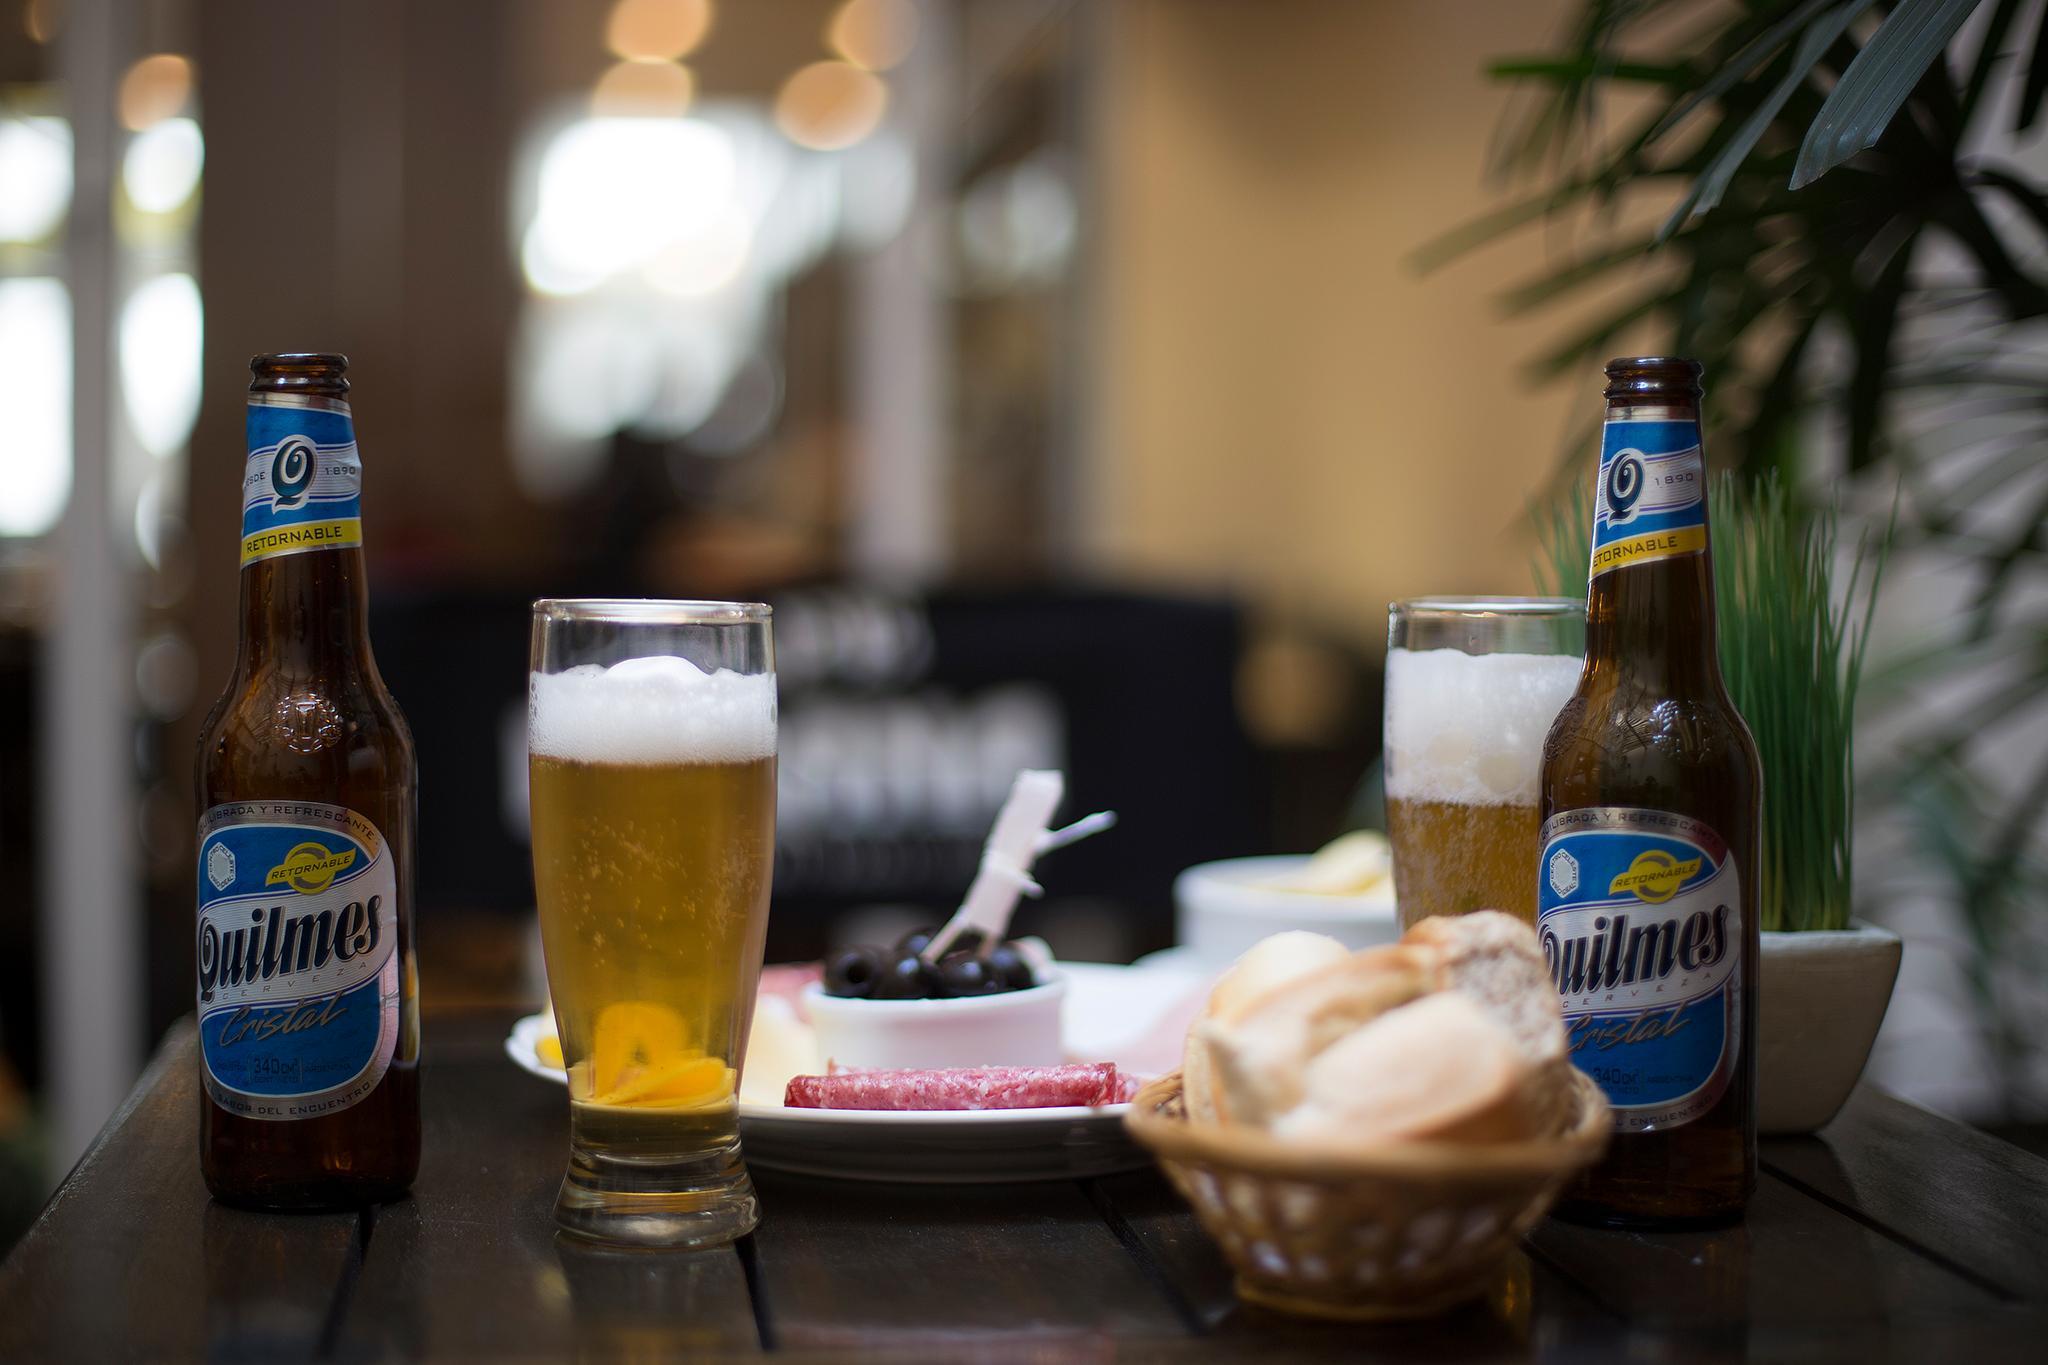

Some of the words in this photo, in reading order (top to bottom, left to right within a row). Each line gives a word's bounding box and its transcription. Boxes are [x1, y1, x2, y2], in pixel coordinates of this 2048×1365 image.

[271, 438, 316, 507] Q
[324, 466, 356, 476] 1890
[1606, 453, 1644, 521] Q
[1654, 473, 1694, 486] 1890
[246, 526, 343, 554] RETORNABLE
[1593, 535, 1678, 568] ETORNABLE
[261, 806, 268, 815] Y
[273, 805, 375, 841] REFRESCANTE
[1603, 812, 1612, 822] Y
[271, 855, 352, 880] RETORNABLE
[1614, 864, 1697, 887] RETORNABLE
[200, 895, 383, 1003] Quilmes
[222, 961, 367, 1000] CERVEZA
[1562, 972, 1711, 1008] CERVEZA
[219, 990, 348, 1047] Cristal
[258, 1107, 283, 1115] DEL
[289, 1081, 371, 1115] ENCUENTRO
